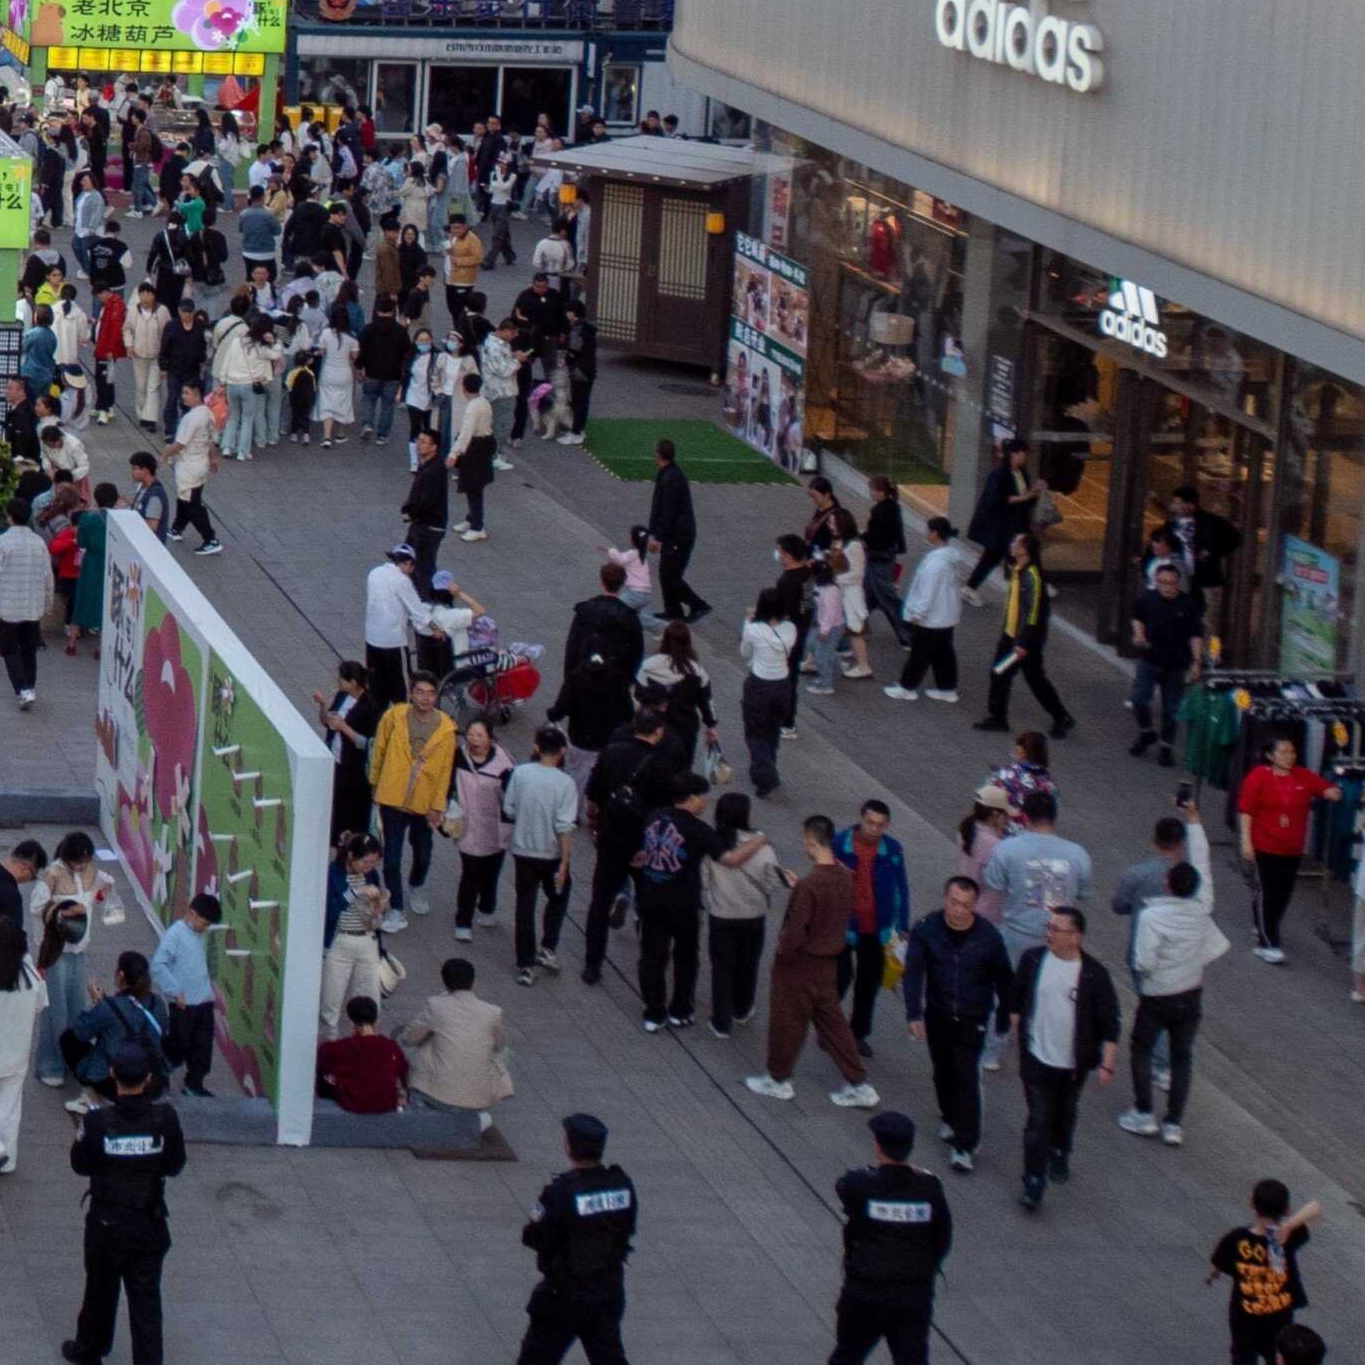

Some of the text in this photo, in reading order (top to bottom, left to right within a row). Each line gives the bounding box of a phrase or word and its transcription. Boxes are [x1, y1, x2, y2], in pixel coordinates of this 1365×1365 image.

[70, 24, 176, 44] 冰糖葫芦
[1099, 309, 1169, 358] adidas
